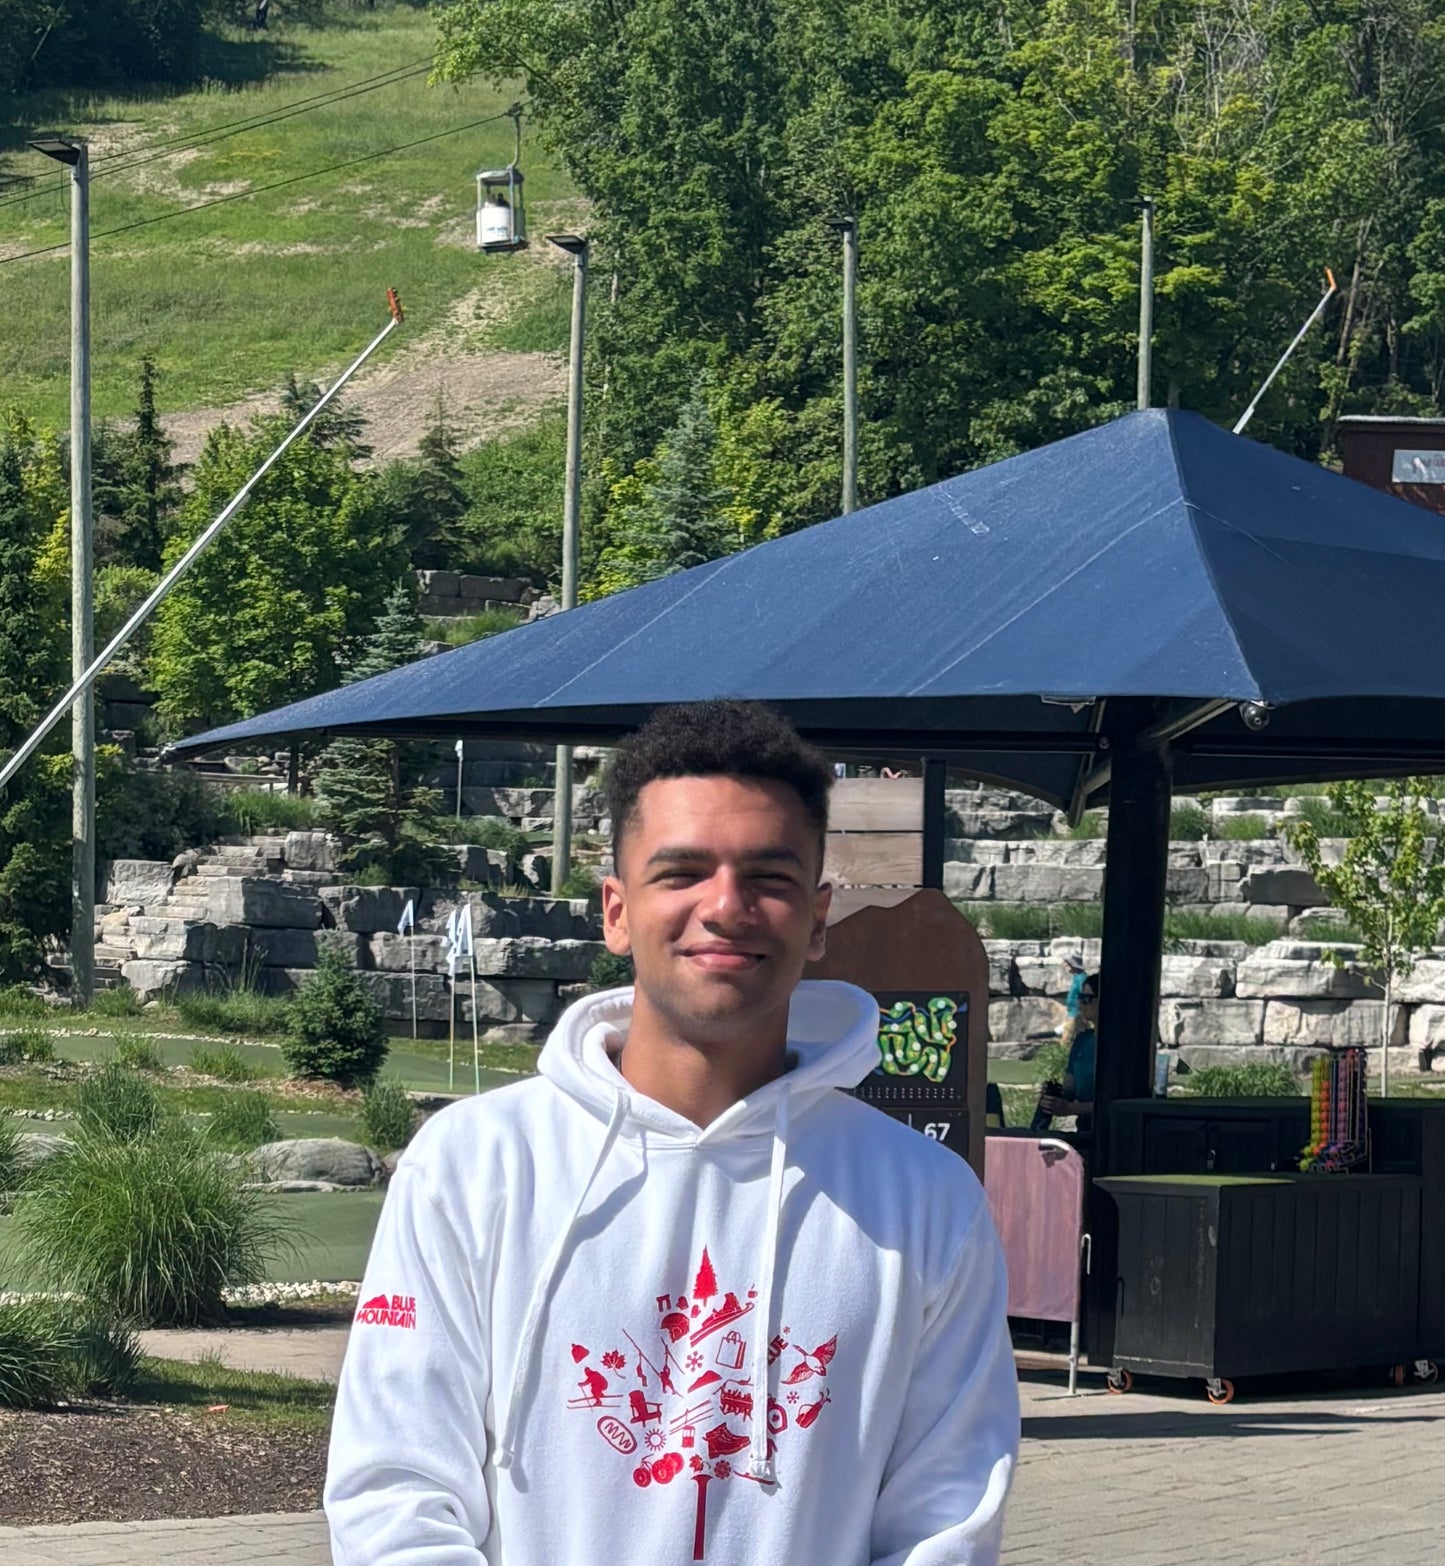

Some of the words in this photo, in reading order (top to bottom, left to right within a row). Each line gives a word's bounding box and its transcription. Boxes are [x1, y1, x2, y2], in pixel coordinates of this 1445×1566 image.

[923, 1122, 951, 1141] 67
[391, 1294, 416, 1312] BLUE
[356, 1309, 417, 1330] MOUNTAIN
